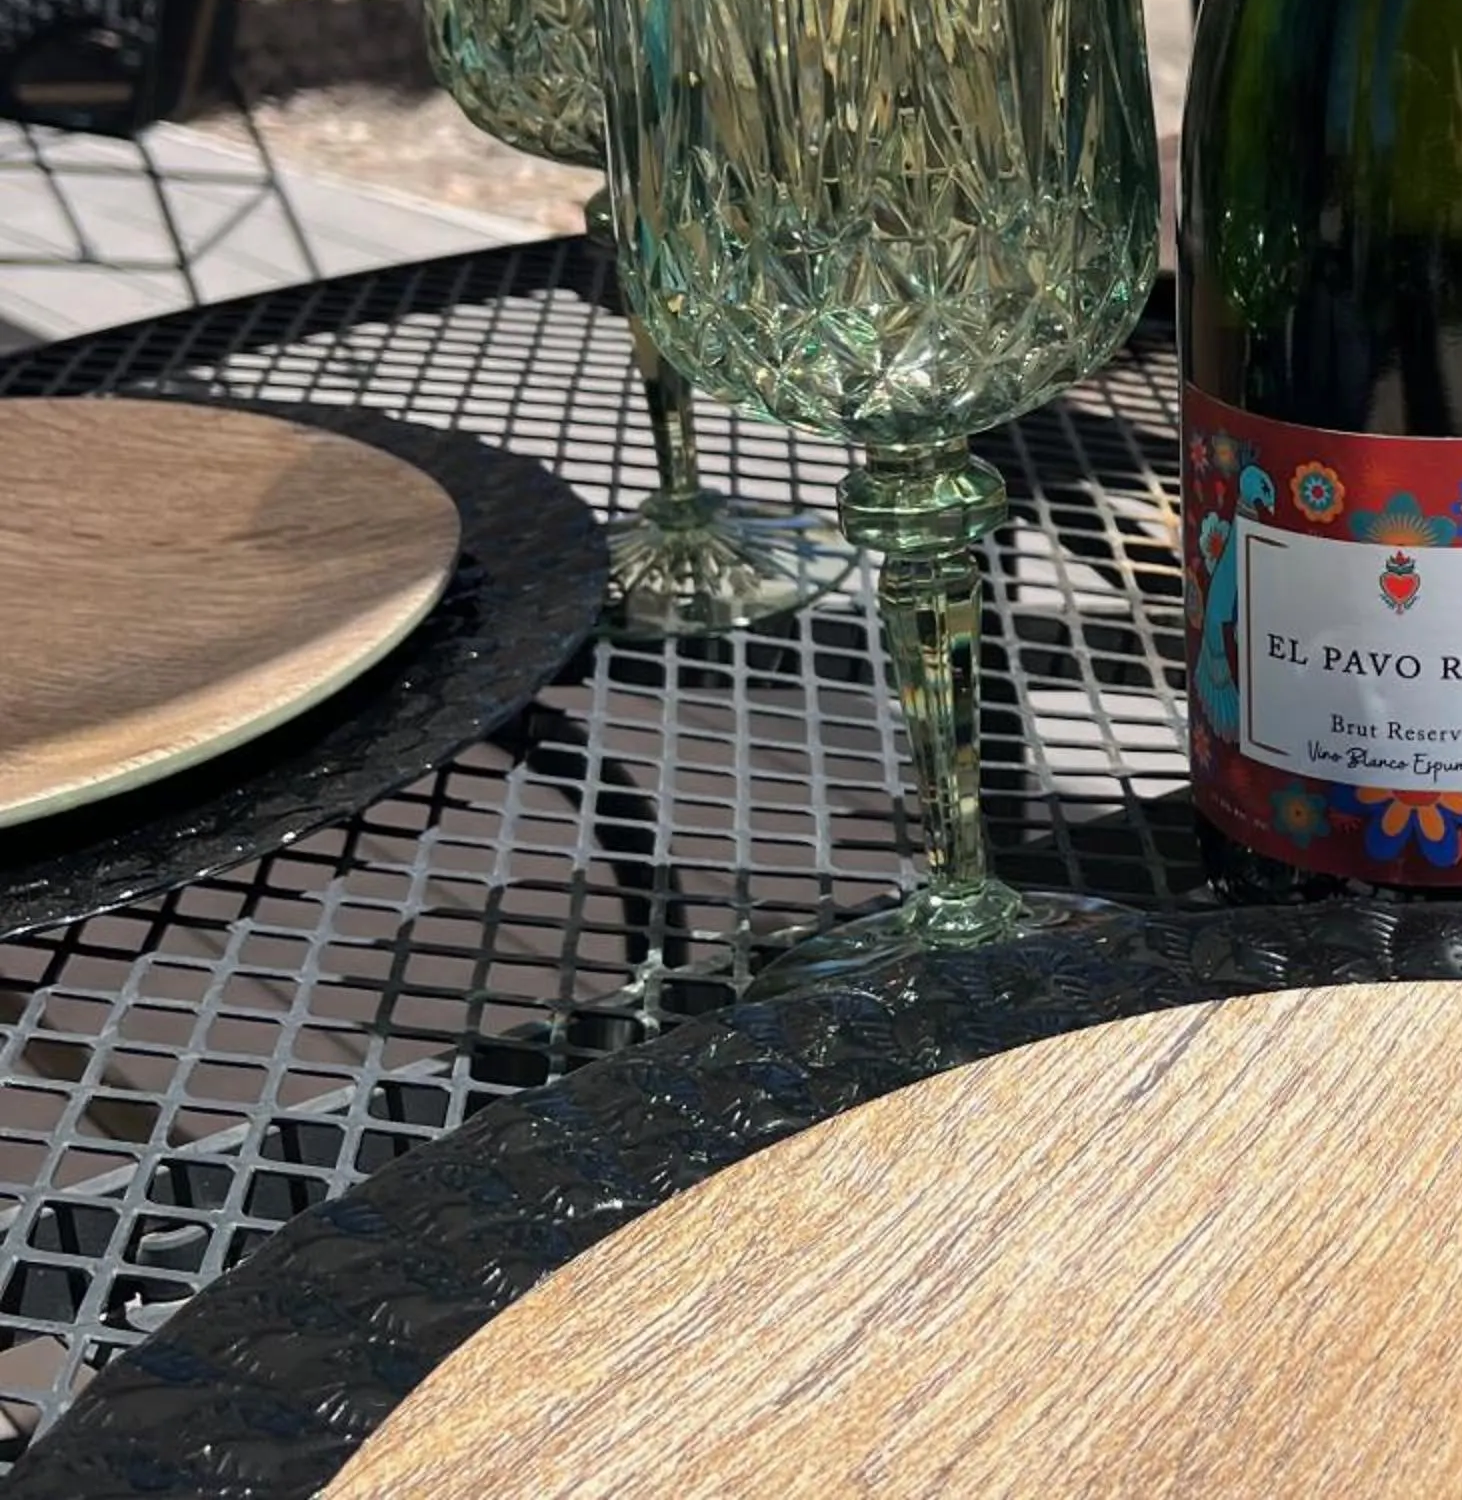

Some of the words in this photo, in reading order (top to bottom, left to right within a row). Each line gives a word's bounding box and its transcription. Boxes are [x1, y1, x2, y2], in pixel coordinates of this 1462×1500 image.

[1267, 633, 1309, 665] EL
[1323, 646, 1422, 680] PAVO
[1331, 713, 1378, 739] Brut
[1308, 740, 1342, 763] Vino
[1346, 747, 1408, 770] Blanco
